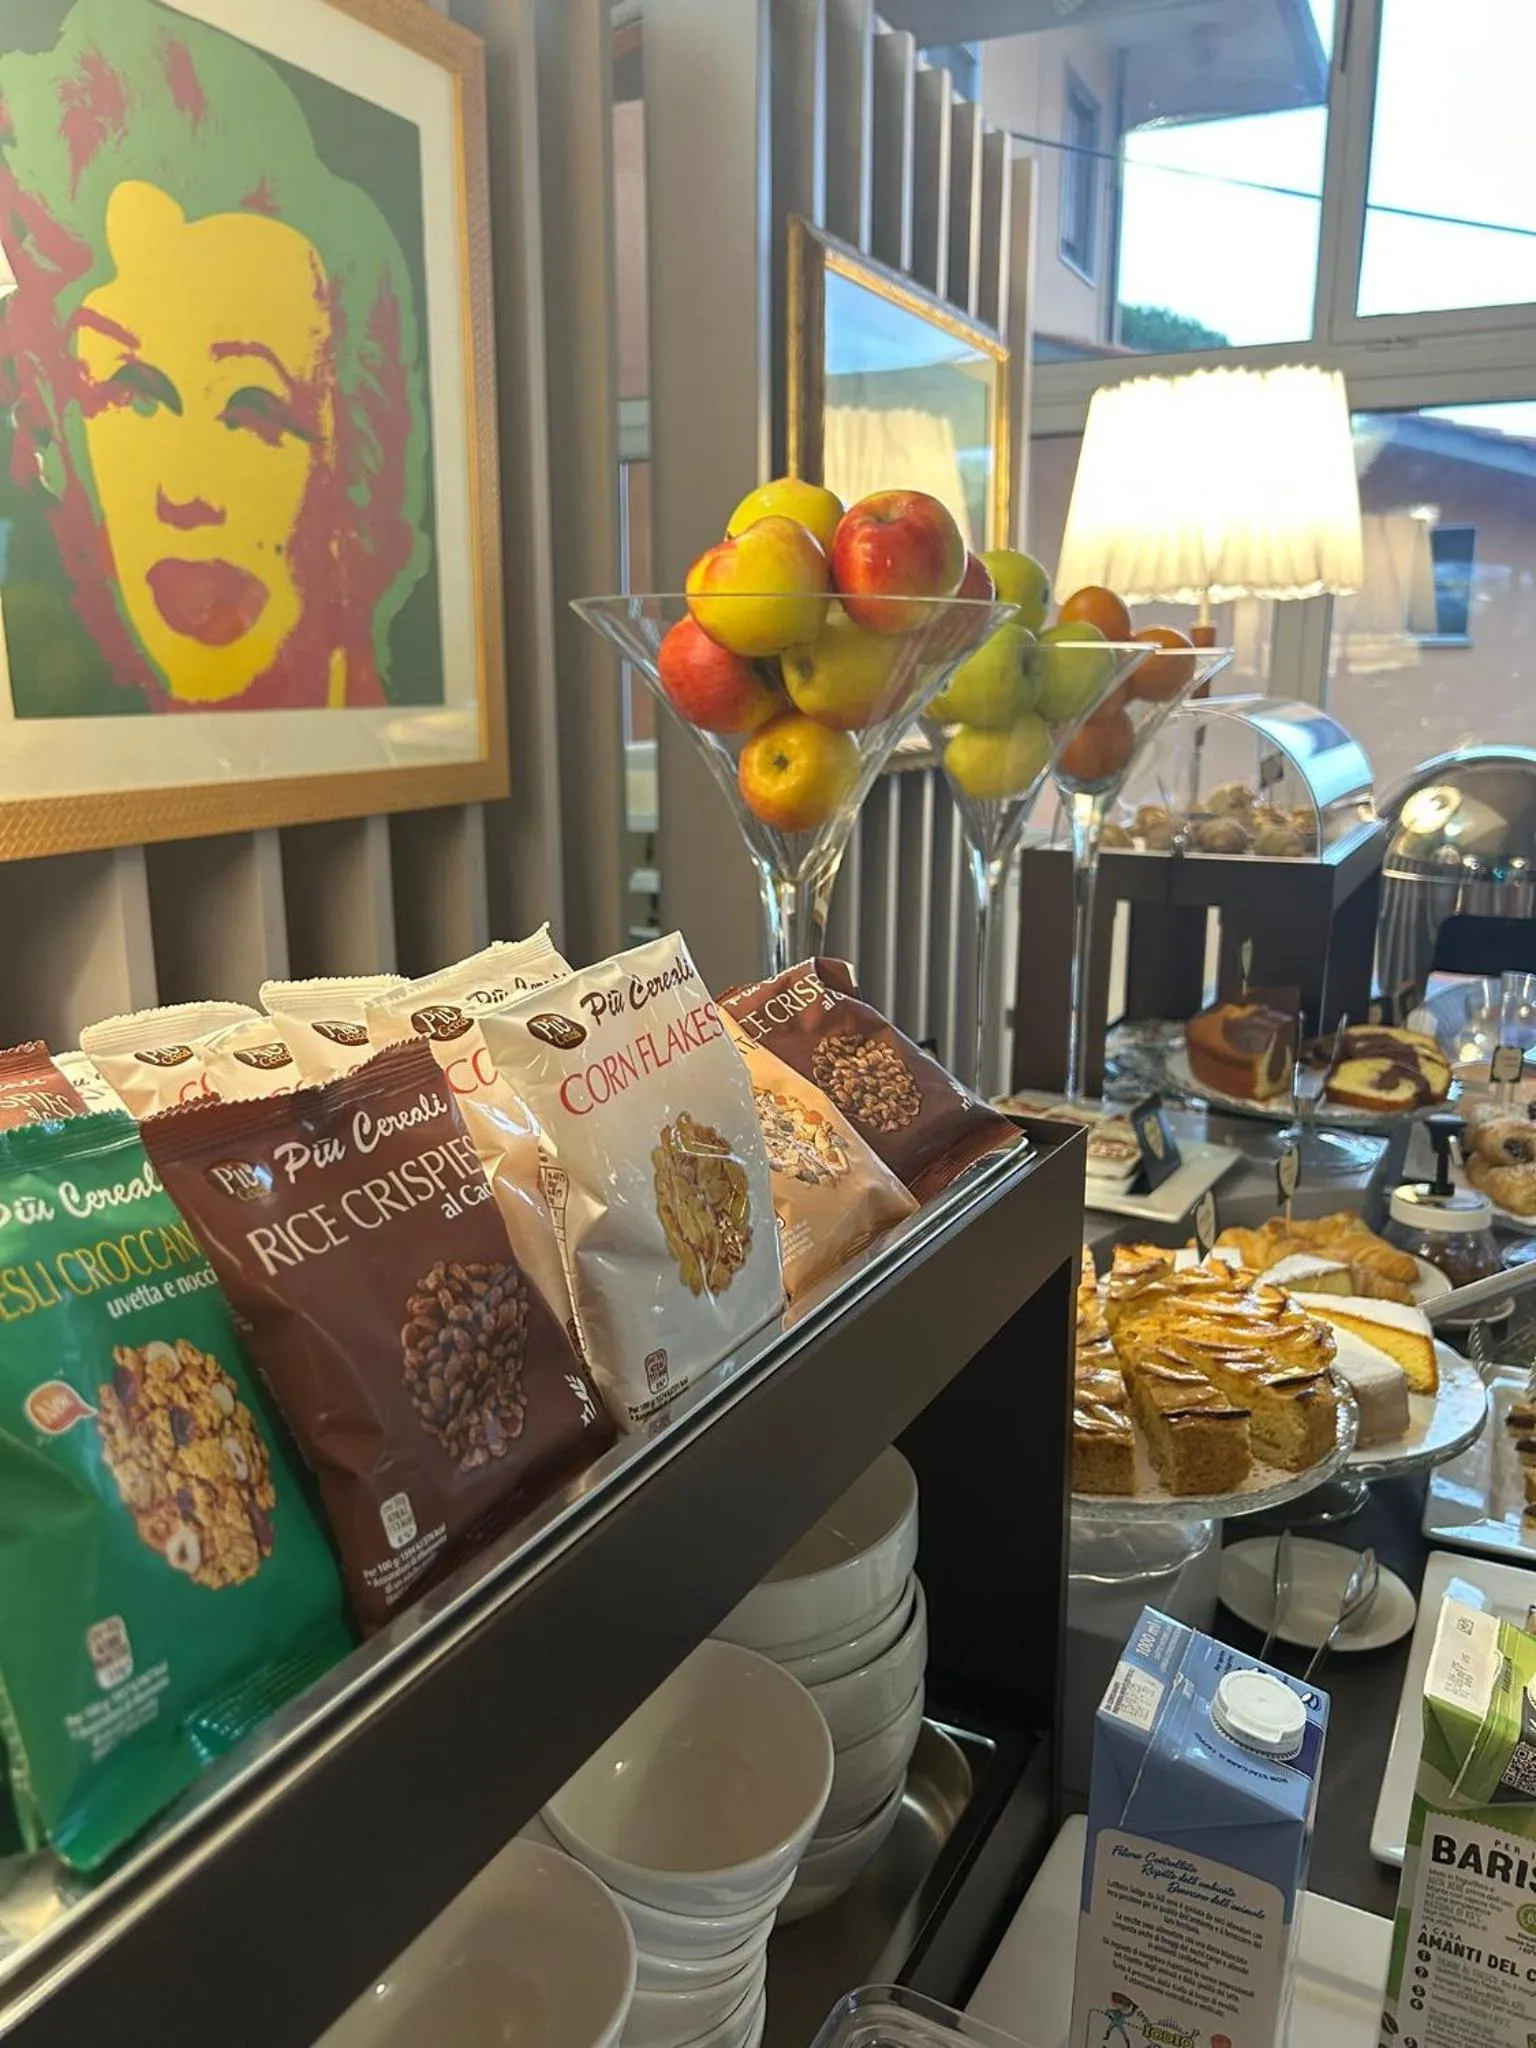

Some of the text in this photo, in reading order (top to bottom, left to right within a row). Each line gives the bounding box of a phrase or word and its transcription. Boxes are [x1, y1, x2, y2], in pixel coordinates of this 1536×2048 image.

[630, 956, 696, 1010] Cereali
[558, 1002, 725, 1115] CORN FLAKES
[352, 1092, 448, 1154] Cereali
[245, 1134, 486, 1277] RICE CRISPIES
[106, 1283, 166, 1320] uvetta
[163, 1279, 178, 1299] e
[1416, 1930, 1483, 1965] AMANTI
[1486, 1953, 1521, 1978] DEL
[1431, 1926, 1463, 1943] CASA
